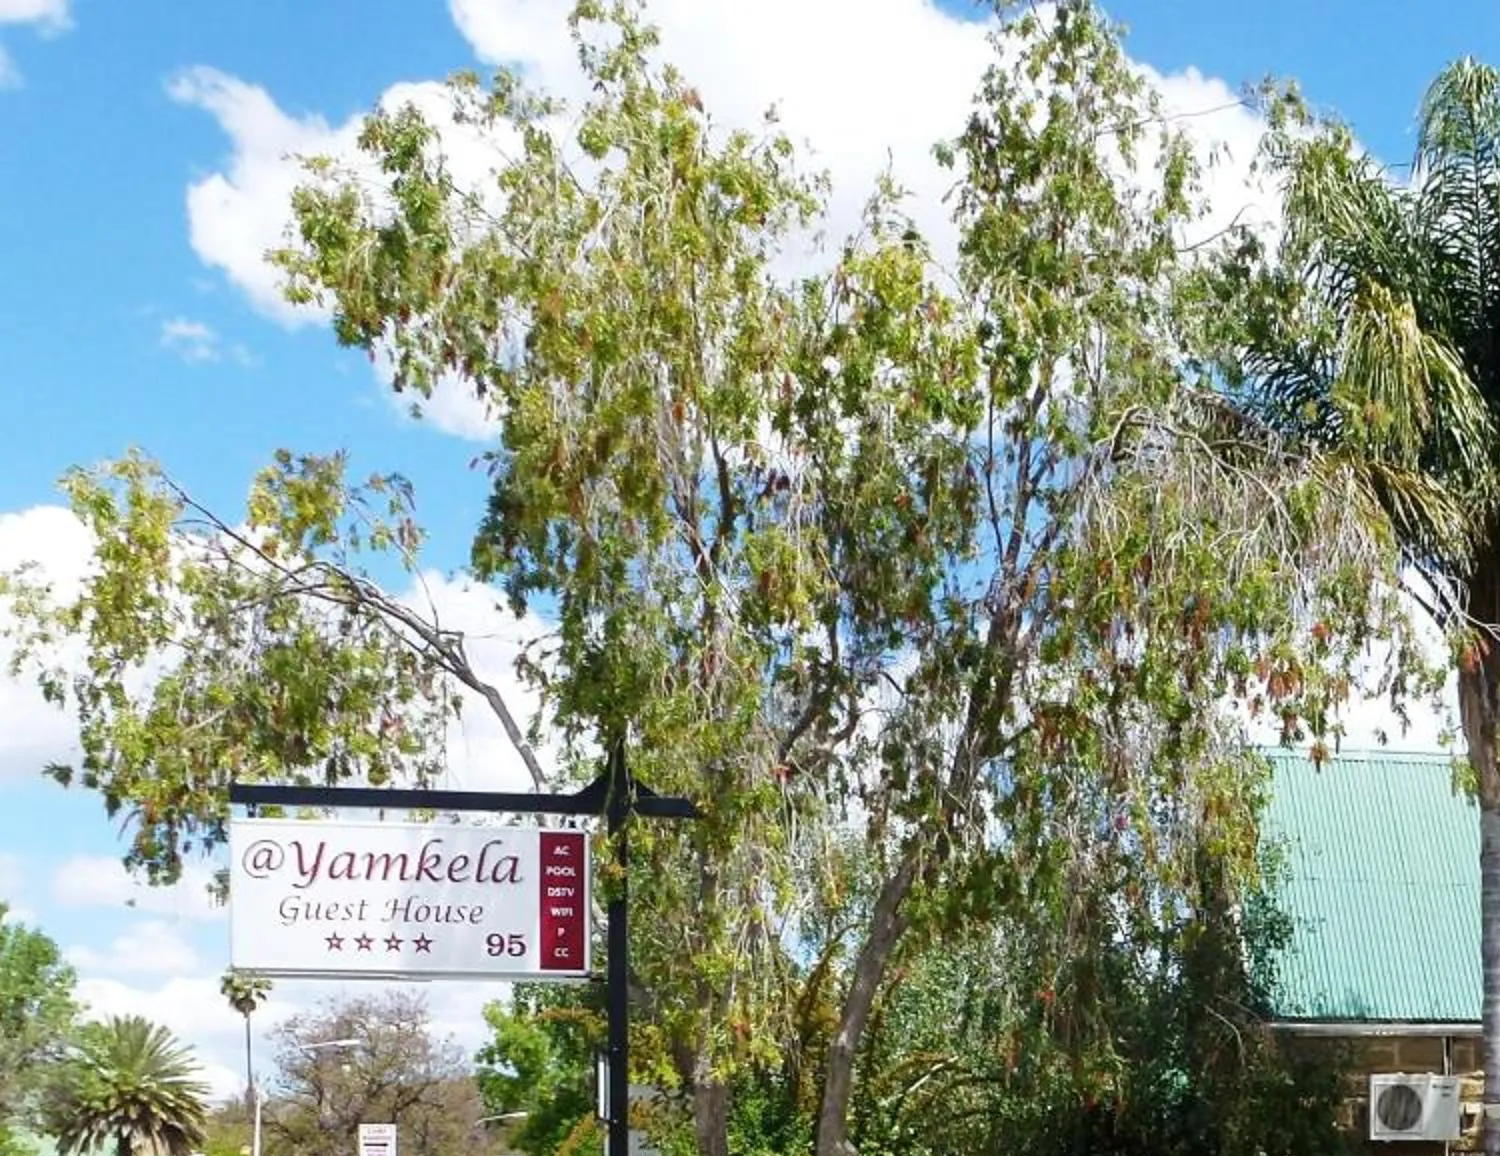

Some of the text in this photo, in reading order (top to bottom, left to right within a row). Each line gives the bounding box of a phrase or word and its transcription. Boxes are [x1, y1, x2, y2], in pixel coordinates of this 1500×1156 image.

[553, 846, 570, 856] AC
[545, 866, 576, 877] POOL
[547, 887, 575, 897] DSTV
[278, 894, 484, 927] Guest House
[486, 933, 527, 958] 95
[554, 947, 570, 958] CC
